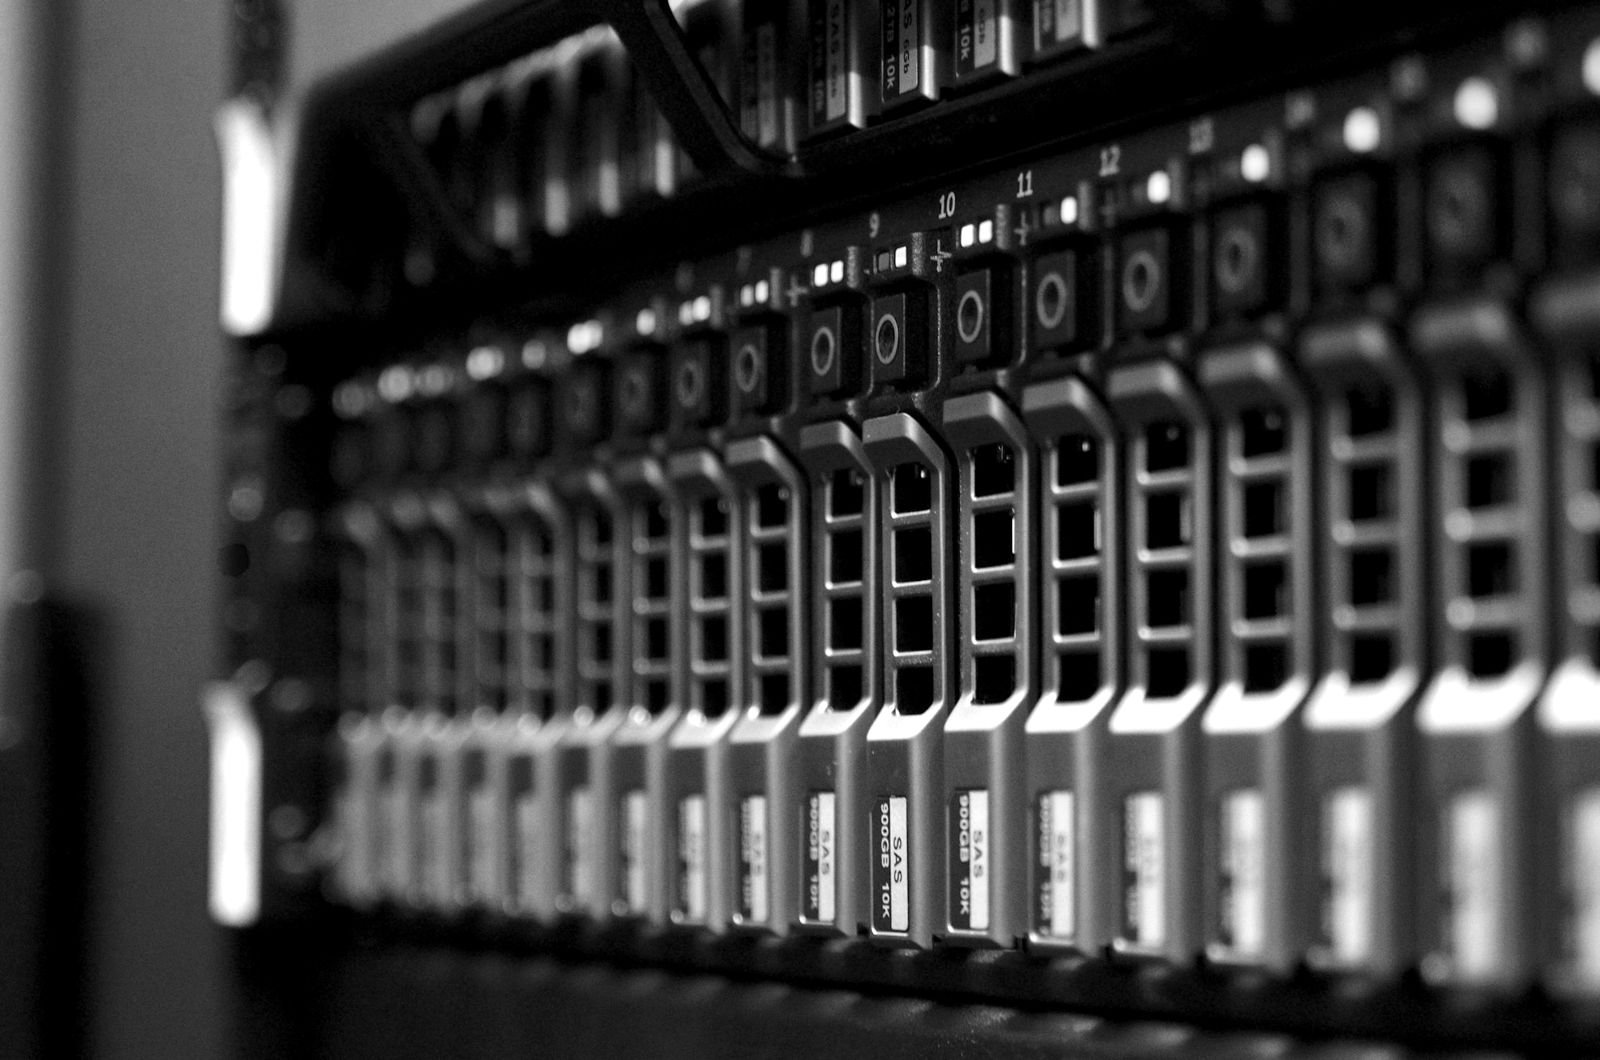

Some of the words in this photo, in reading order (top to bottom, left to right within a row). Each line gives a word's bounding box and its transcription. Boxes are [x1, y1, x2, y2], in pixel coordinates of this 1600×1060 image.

[1099, 144, 1121, 177] 12
[1016, 170, 1034, 198] 11
[868, 211, 880, 238] 9
[938, 191, 956, 220] 10
[880, 802, 889, 869] 900GB
[958, 795, 969, 863] 900GB
[892, 835, 903, 884] SAS
[973, 830, 984, 878] SAS
[881, 881, 890, 918] 10K
[959, 876, 970, 915] 10K
